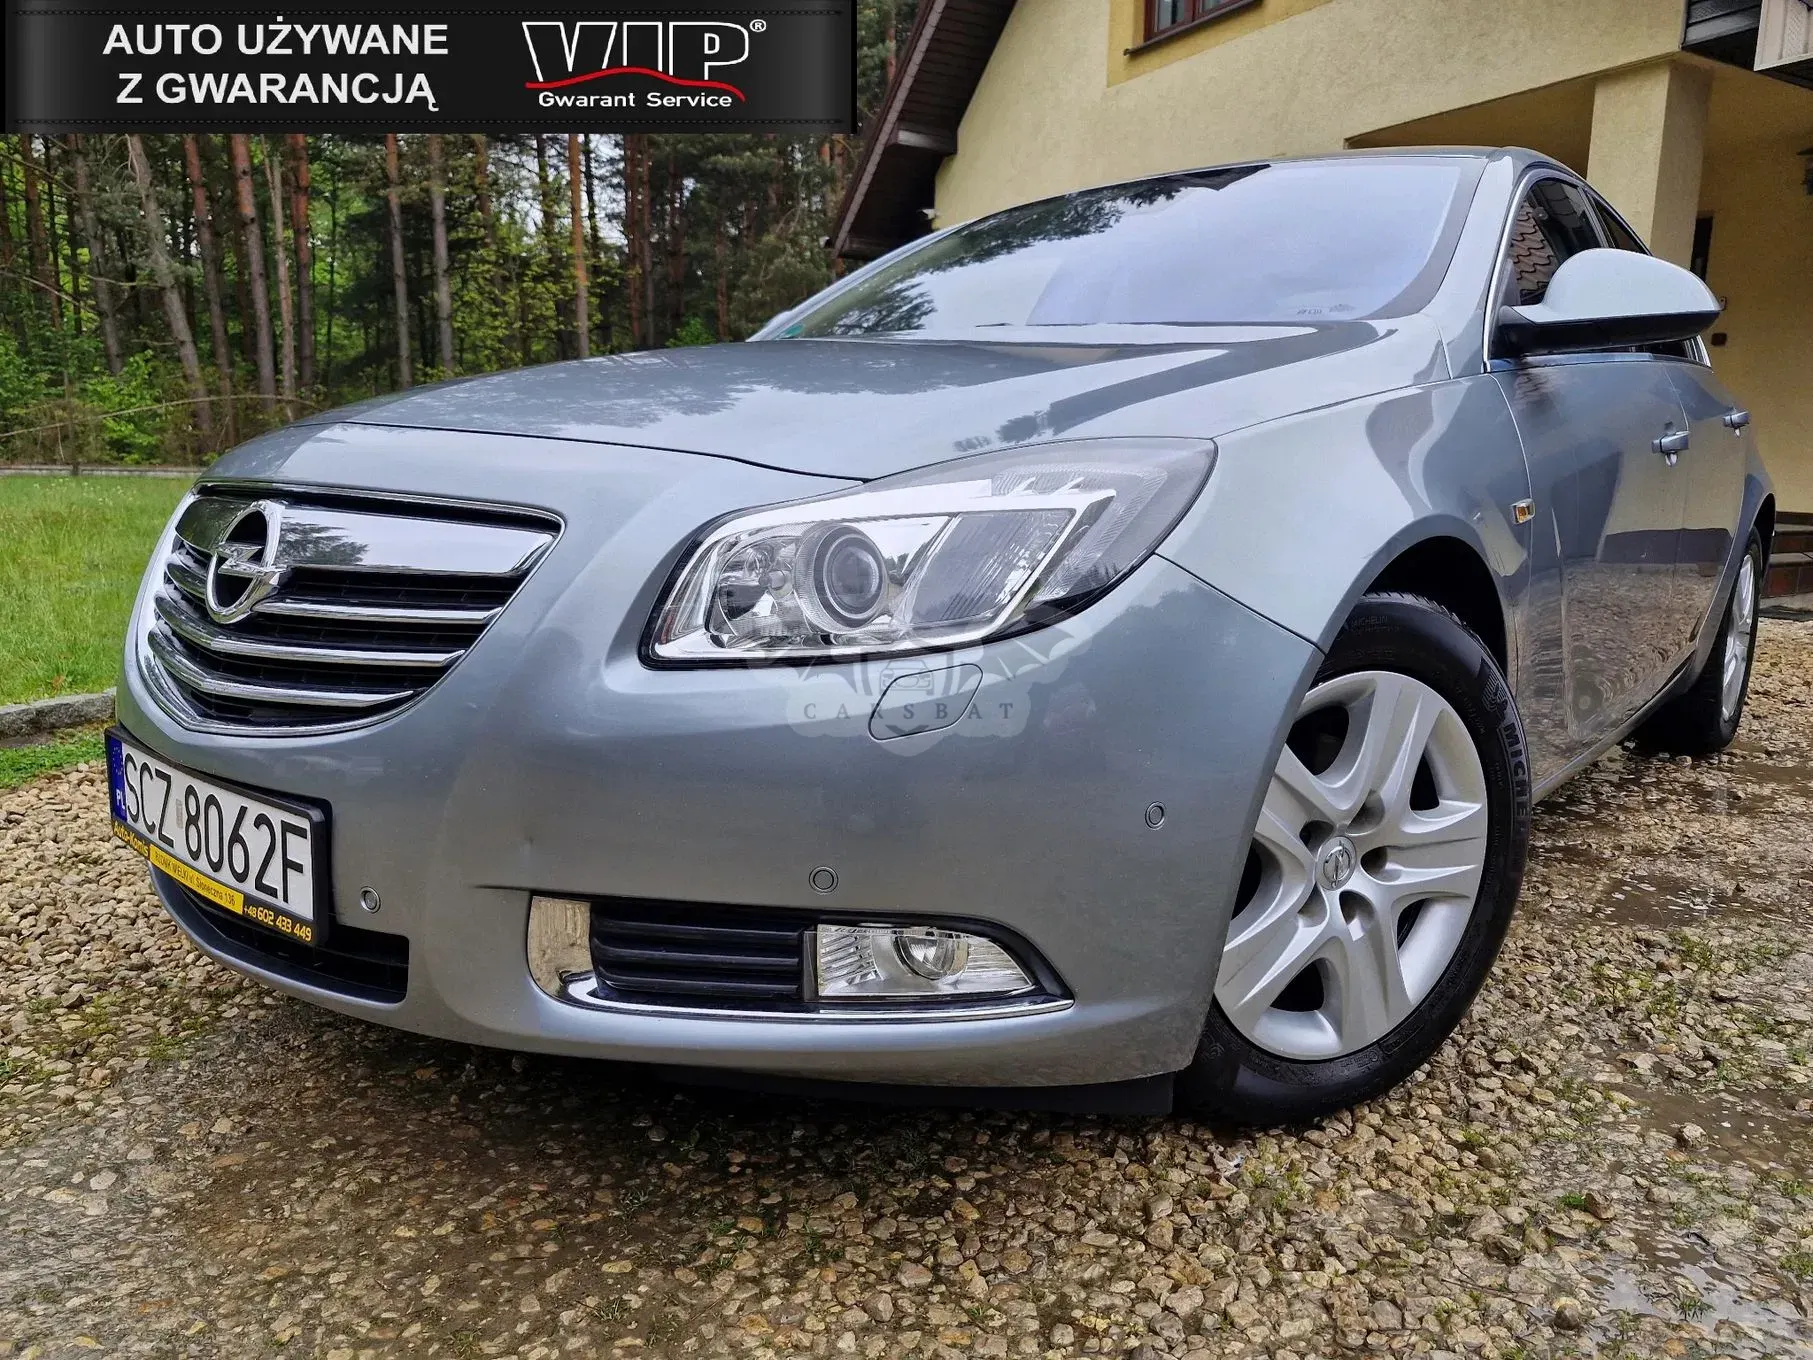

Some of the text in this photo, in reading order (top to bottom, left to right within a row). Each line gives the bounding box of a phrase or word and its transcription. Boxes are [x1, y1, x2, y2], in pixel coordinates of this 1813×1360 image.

[116, 788, 126, 810] PL
[124, 752, 309, 904] SCZ 8062F
[243, 905, 312, 941] +48 602 433 449
